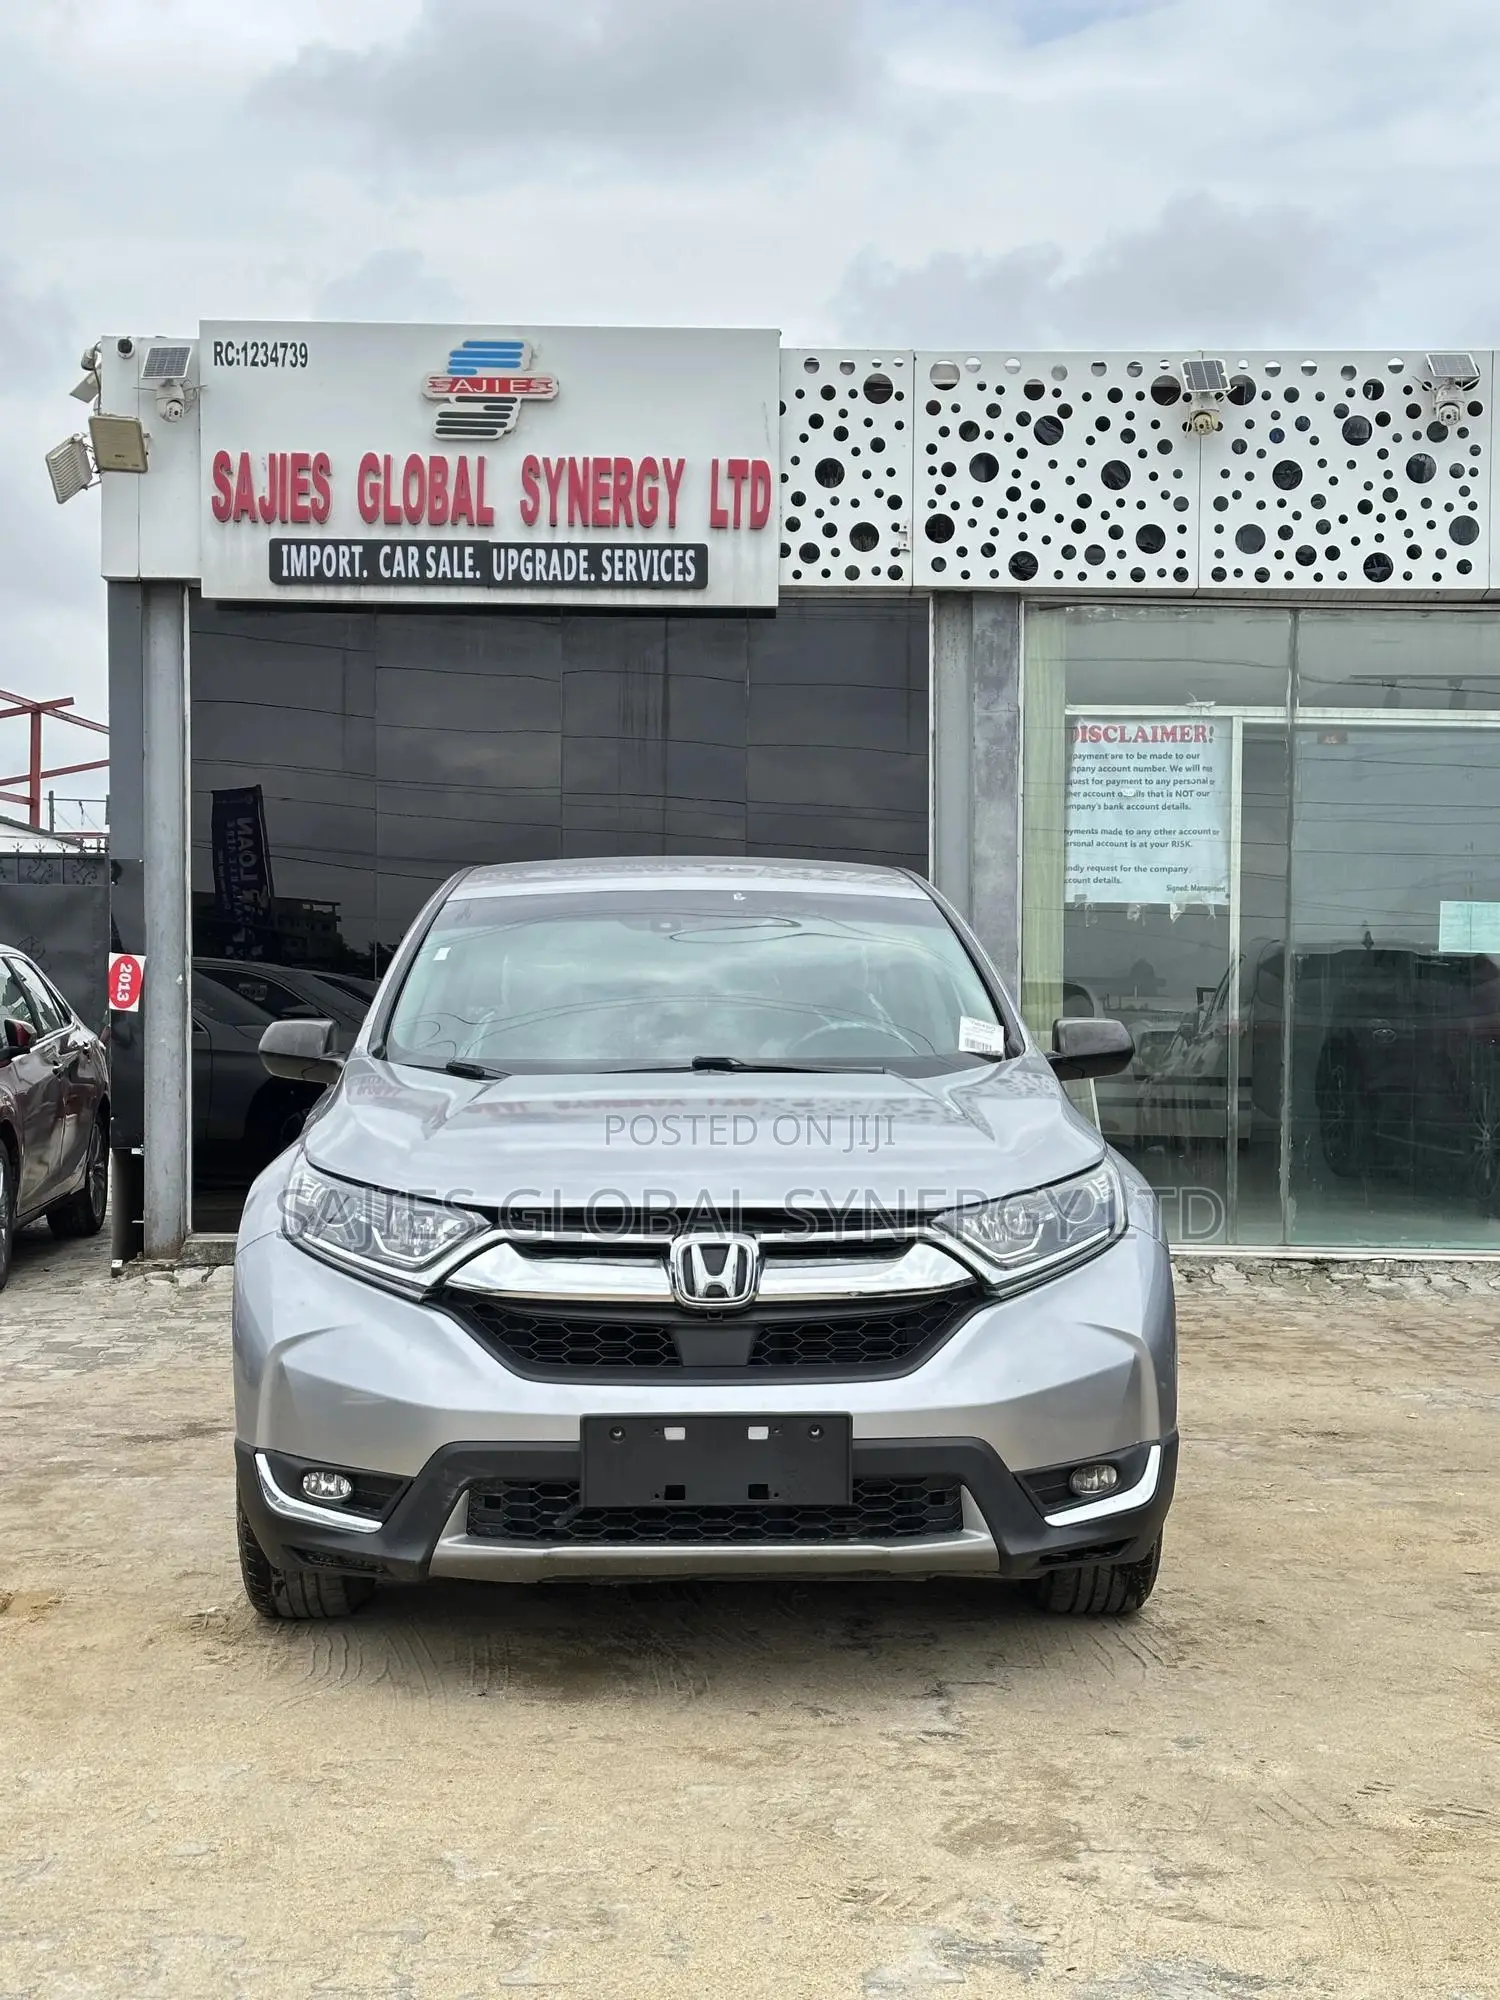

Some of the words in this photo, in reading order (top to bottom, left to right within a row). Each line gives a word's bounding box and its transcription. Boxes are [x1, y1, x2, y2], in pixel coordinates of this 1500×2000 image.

[213, 341, 309, 368] RC:1234739
[428, 376, 554, 394] SAJIES
[211, 450, 332, 524] SAJIES
[357, 451, 495, 526] GLOBAL
[519, 454, 686, 528] SYNERGY
[709, 458, 772, 530] LTD
[281, 544, 368, 579] IMPORT.
[379, 545, 420, 579] CAR
[425, 546, 481, 580] SALE.
[492, 547, 596, 583] UPGRADE.
[601, 548, 696, 583] SERVICES
[1137, 752, 1147, 760] be
[1150, 752, 1173, 760] made
[1106, 778, 1142, 786] payment
[1156, 778, 1170, 786] any
[1173, 777, 1208, 786] personal
[1104, 802, 1124, 810] bank
[1101, 827, 1122, 835] made
[1136, 829, 1150, 837] any
[1150, 841, 1169, 849] your
[1171, 840, 1192, 848] RISK.
[1087, 864, 1118, 873] request
[1120, 864, 1132, 872] for
[1150, 866, 1188, 874] company
[1093, 876, 1122, 884] details.
[117, 963, 133, 1002] 2013
